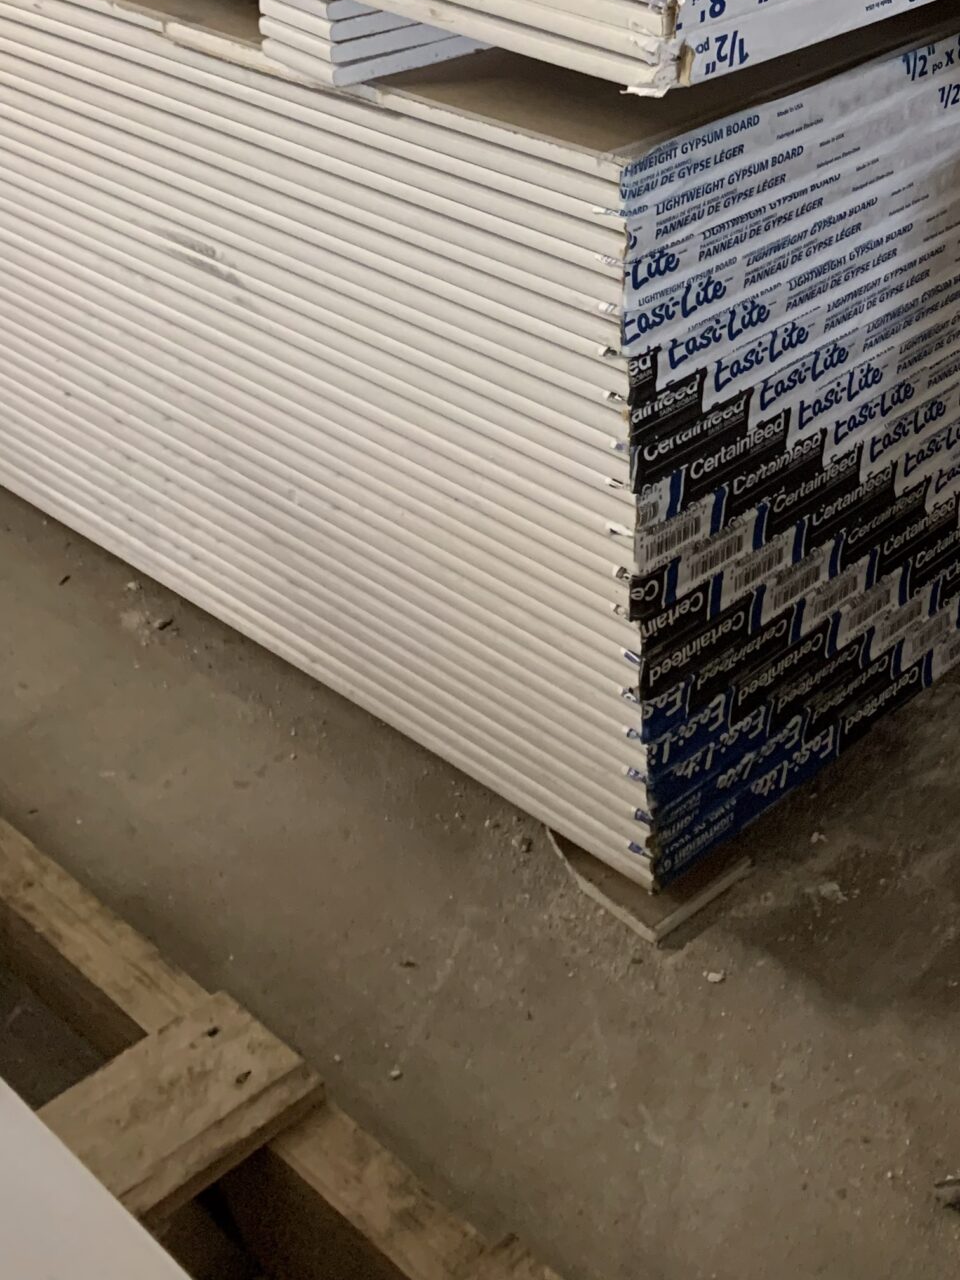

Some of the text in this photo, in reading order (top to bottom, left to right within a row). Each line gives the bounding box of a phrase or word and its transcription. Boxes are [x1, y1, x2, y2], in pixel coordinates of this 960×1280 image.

[695, 30, 749, 75] 1/2" po
[945, 48, 954, 67] x
[660, 143, 744, 186] DE GYPSE LÉGER
[681, 130, 724, 154] GYPSUM
[727, 115, 760, 137] BOARD
[655, 173, 786, 239] PANNEAU DE GYPSE LÉGER
[656, 145, 804, 216] LIGHTWEIGHT GYPSUM BOARD
[690, 413, 785, 480] CertainTeed
[732, 432, 822, 495] CertainTeed
[773, 446, 858, 513] CertainTeed
[650, 611, 745, 685] CertainTeed
